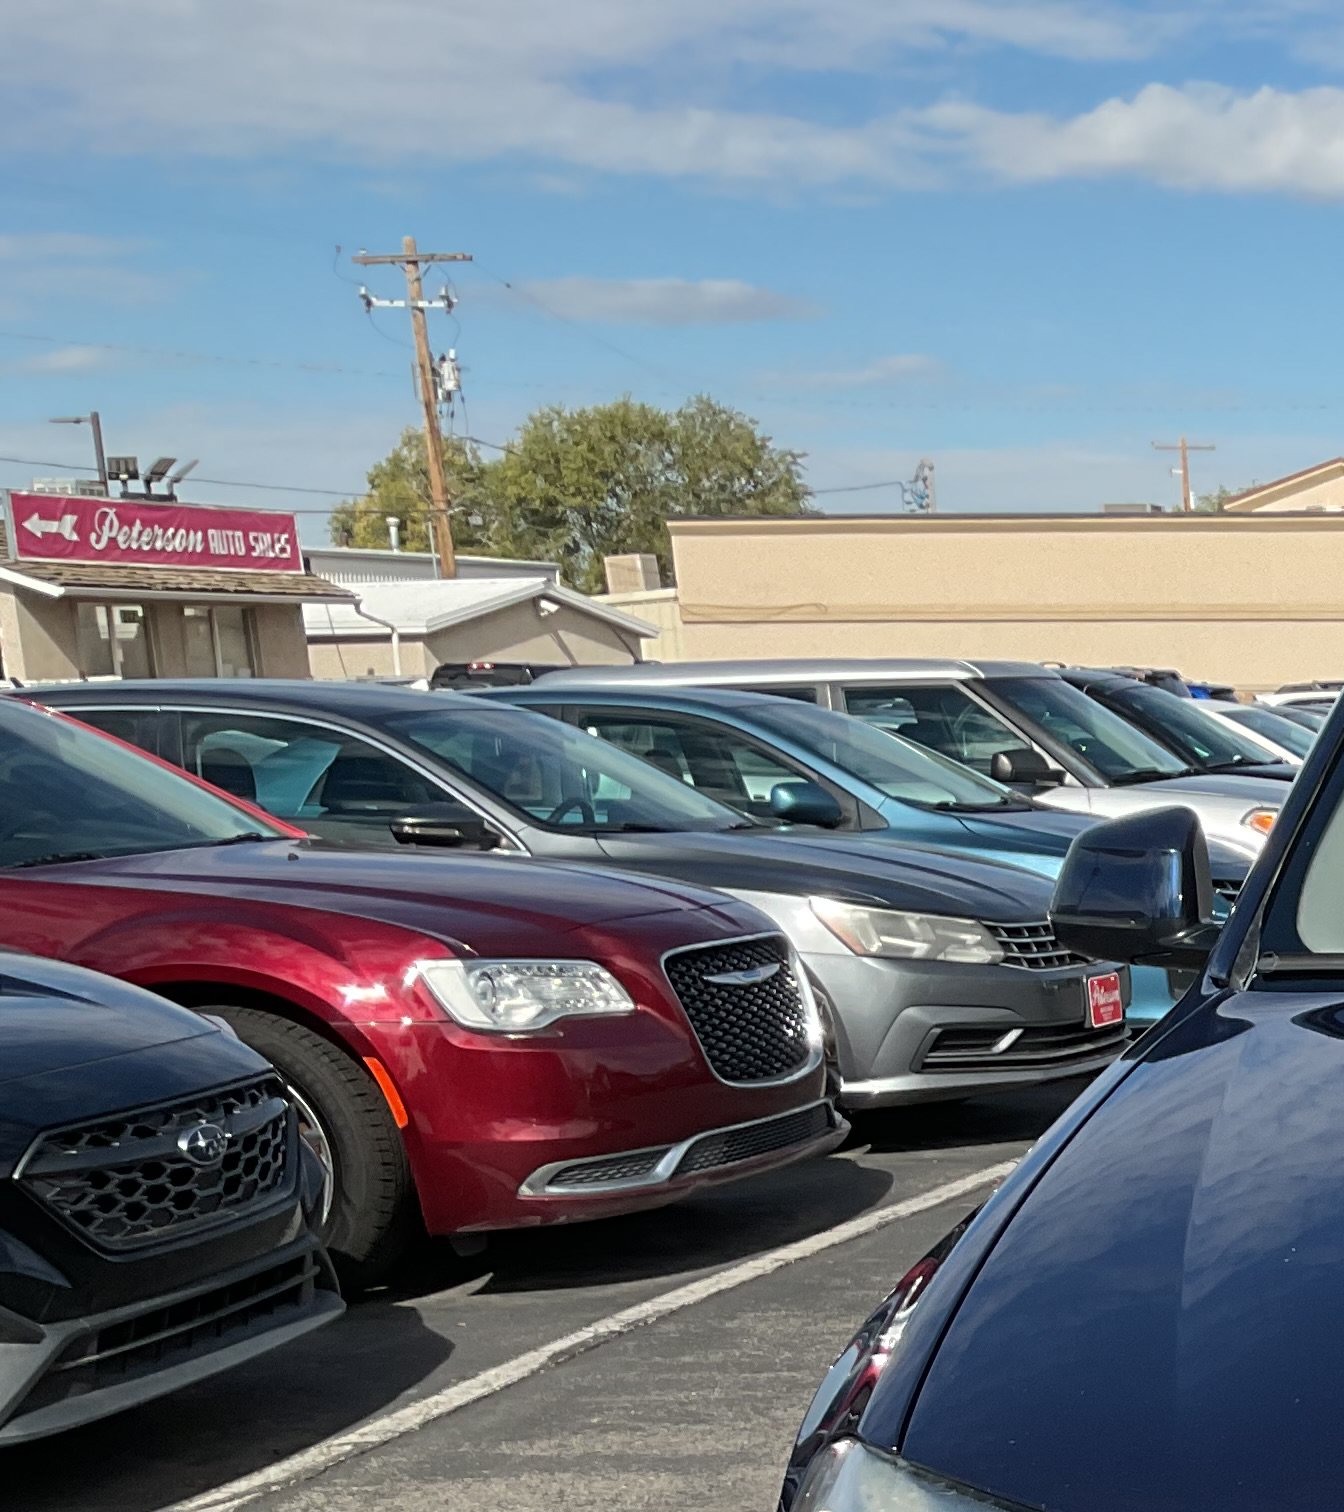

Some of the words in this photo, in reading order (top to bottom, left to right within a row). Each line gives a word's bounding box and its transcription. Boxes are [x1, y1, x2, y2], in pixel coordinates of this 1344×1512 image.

[89, 507, 205, 553] Peterson
[208, 528, 245, 557] AUTO
[249, 532, 291, 559] SALES
